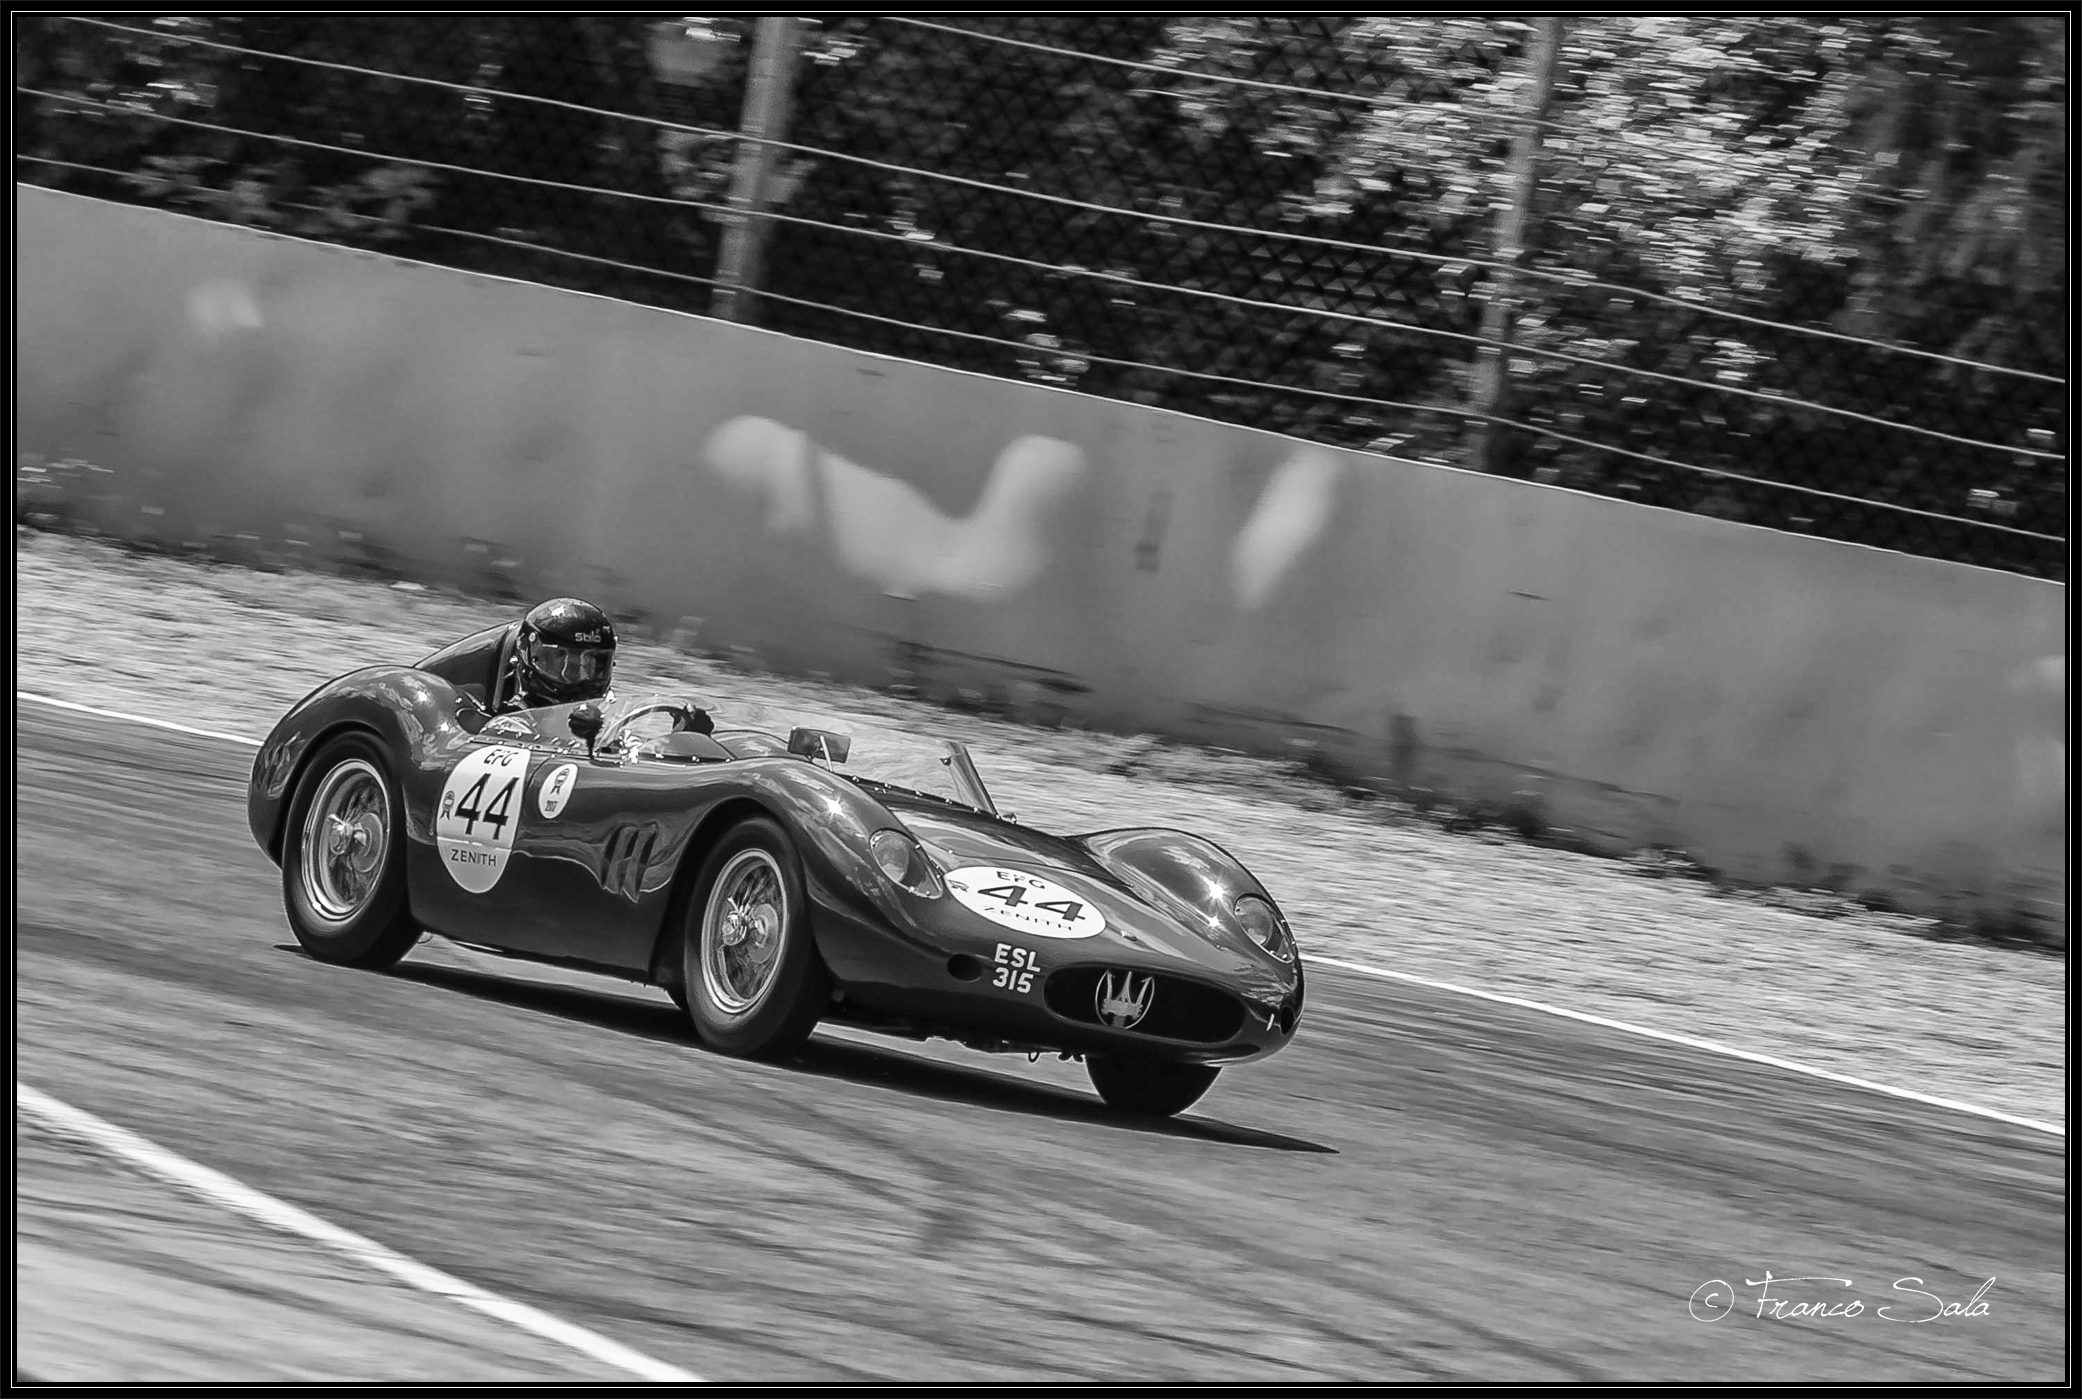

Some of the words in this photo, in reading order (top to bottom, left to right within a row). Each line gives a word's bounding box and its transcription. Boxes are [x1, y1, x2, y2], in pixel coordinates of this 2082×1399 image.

[454, 772, 520, 840] 44
[451, 849, 497, 867] ZENITH
[977, 884, 1086, 922] 44
[983, 905, 1073, 931] ZENITH
[994, 942, 1041, 973] ESL
[992, 966, 1035, 994] 315
